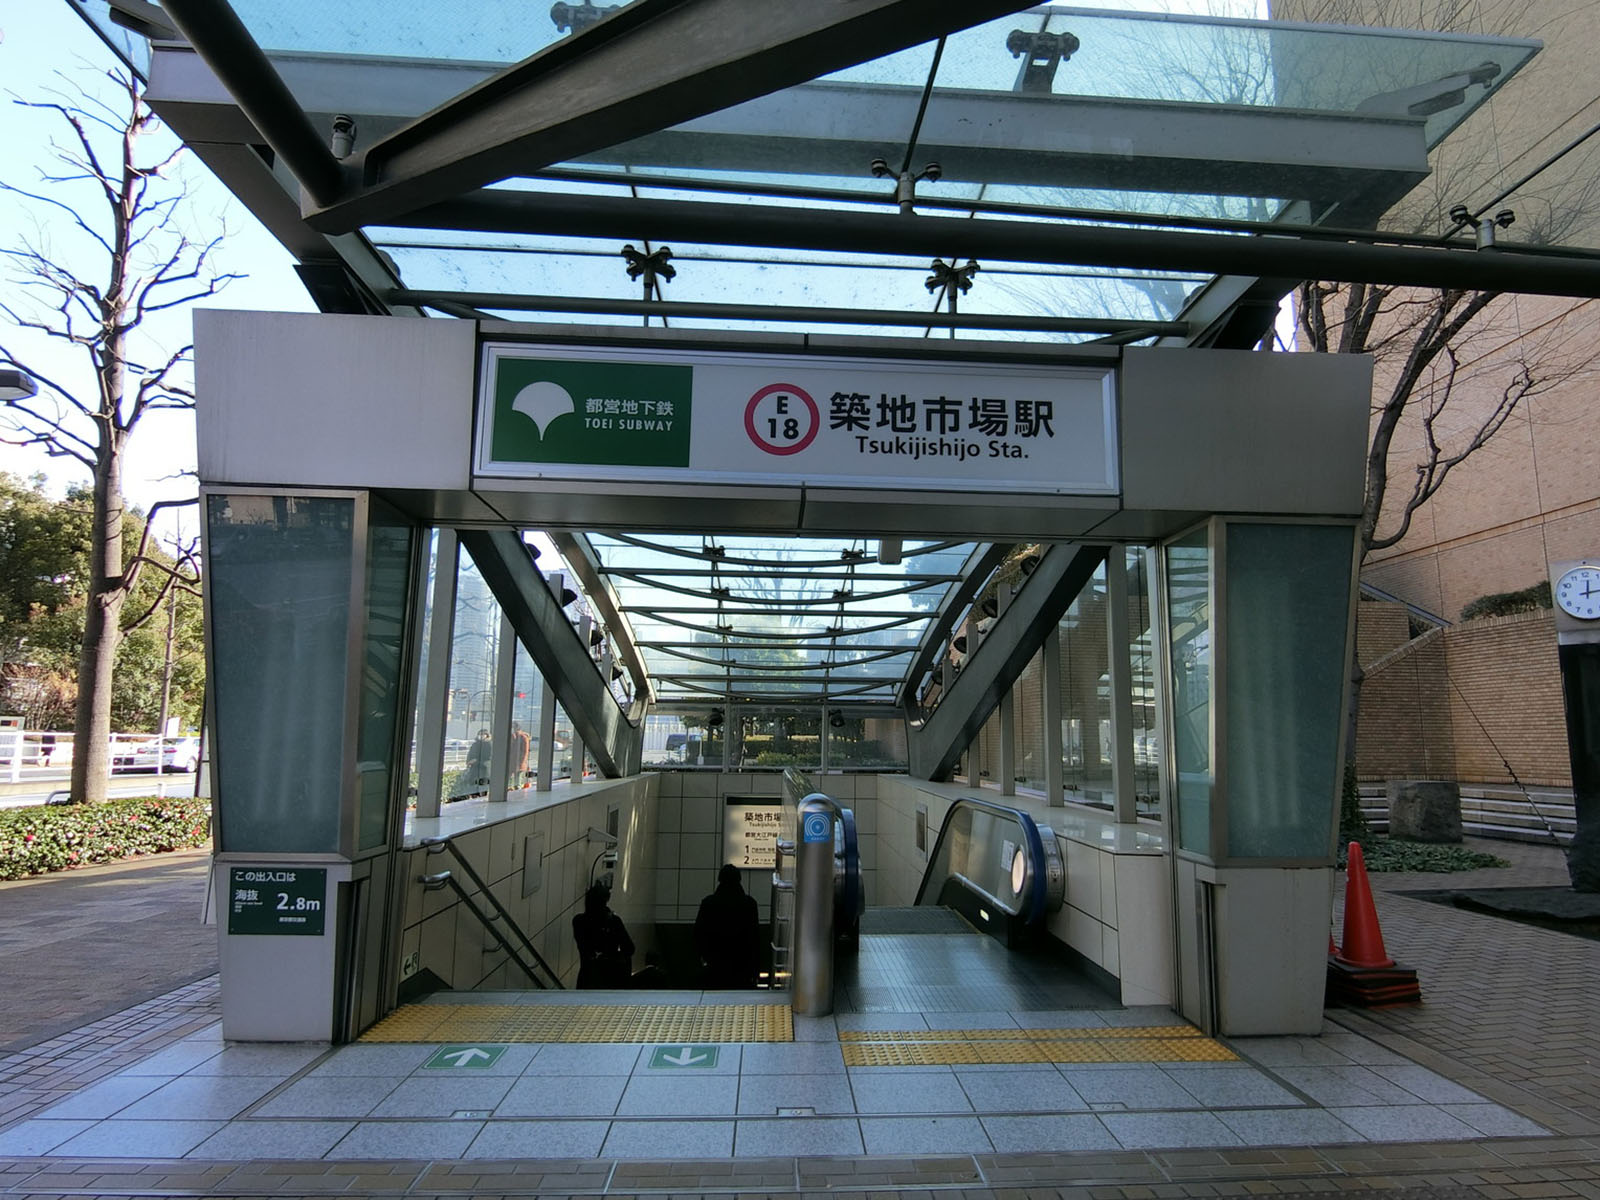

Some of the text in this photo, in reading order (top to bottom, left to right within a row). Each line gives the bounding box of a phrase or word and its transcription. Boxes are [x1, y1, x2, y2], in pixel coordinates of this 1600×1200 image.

[585, 398, 674, 416] 都営地下鉄
[777, 396, 789, 414] E
[830, 392, 1054, 438] 築地市場駅
[585, 418, 673, 431] TOEI SUBWAY
[768, 418, 799, 440] 18
[856, 436, 1029, 461] Tsukijishijo Sta.
[745, 845, 749, 853] 1
[744, 856, 749, 864] 2
[235, 872, 296, 881] この出入口は
[235, 889, 320, 910] 海抜 2.8m
